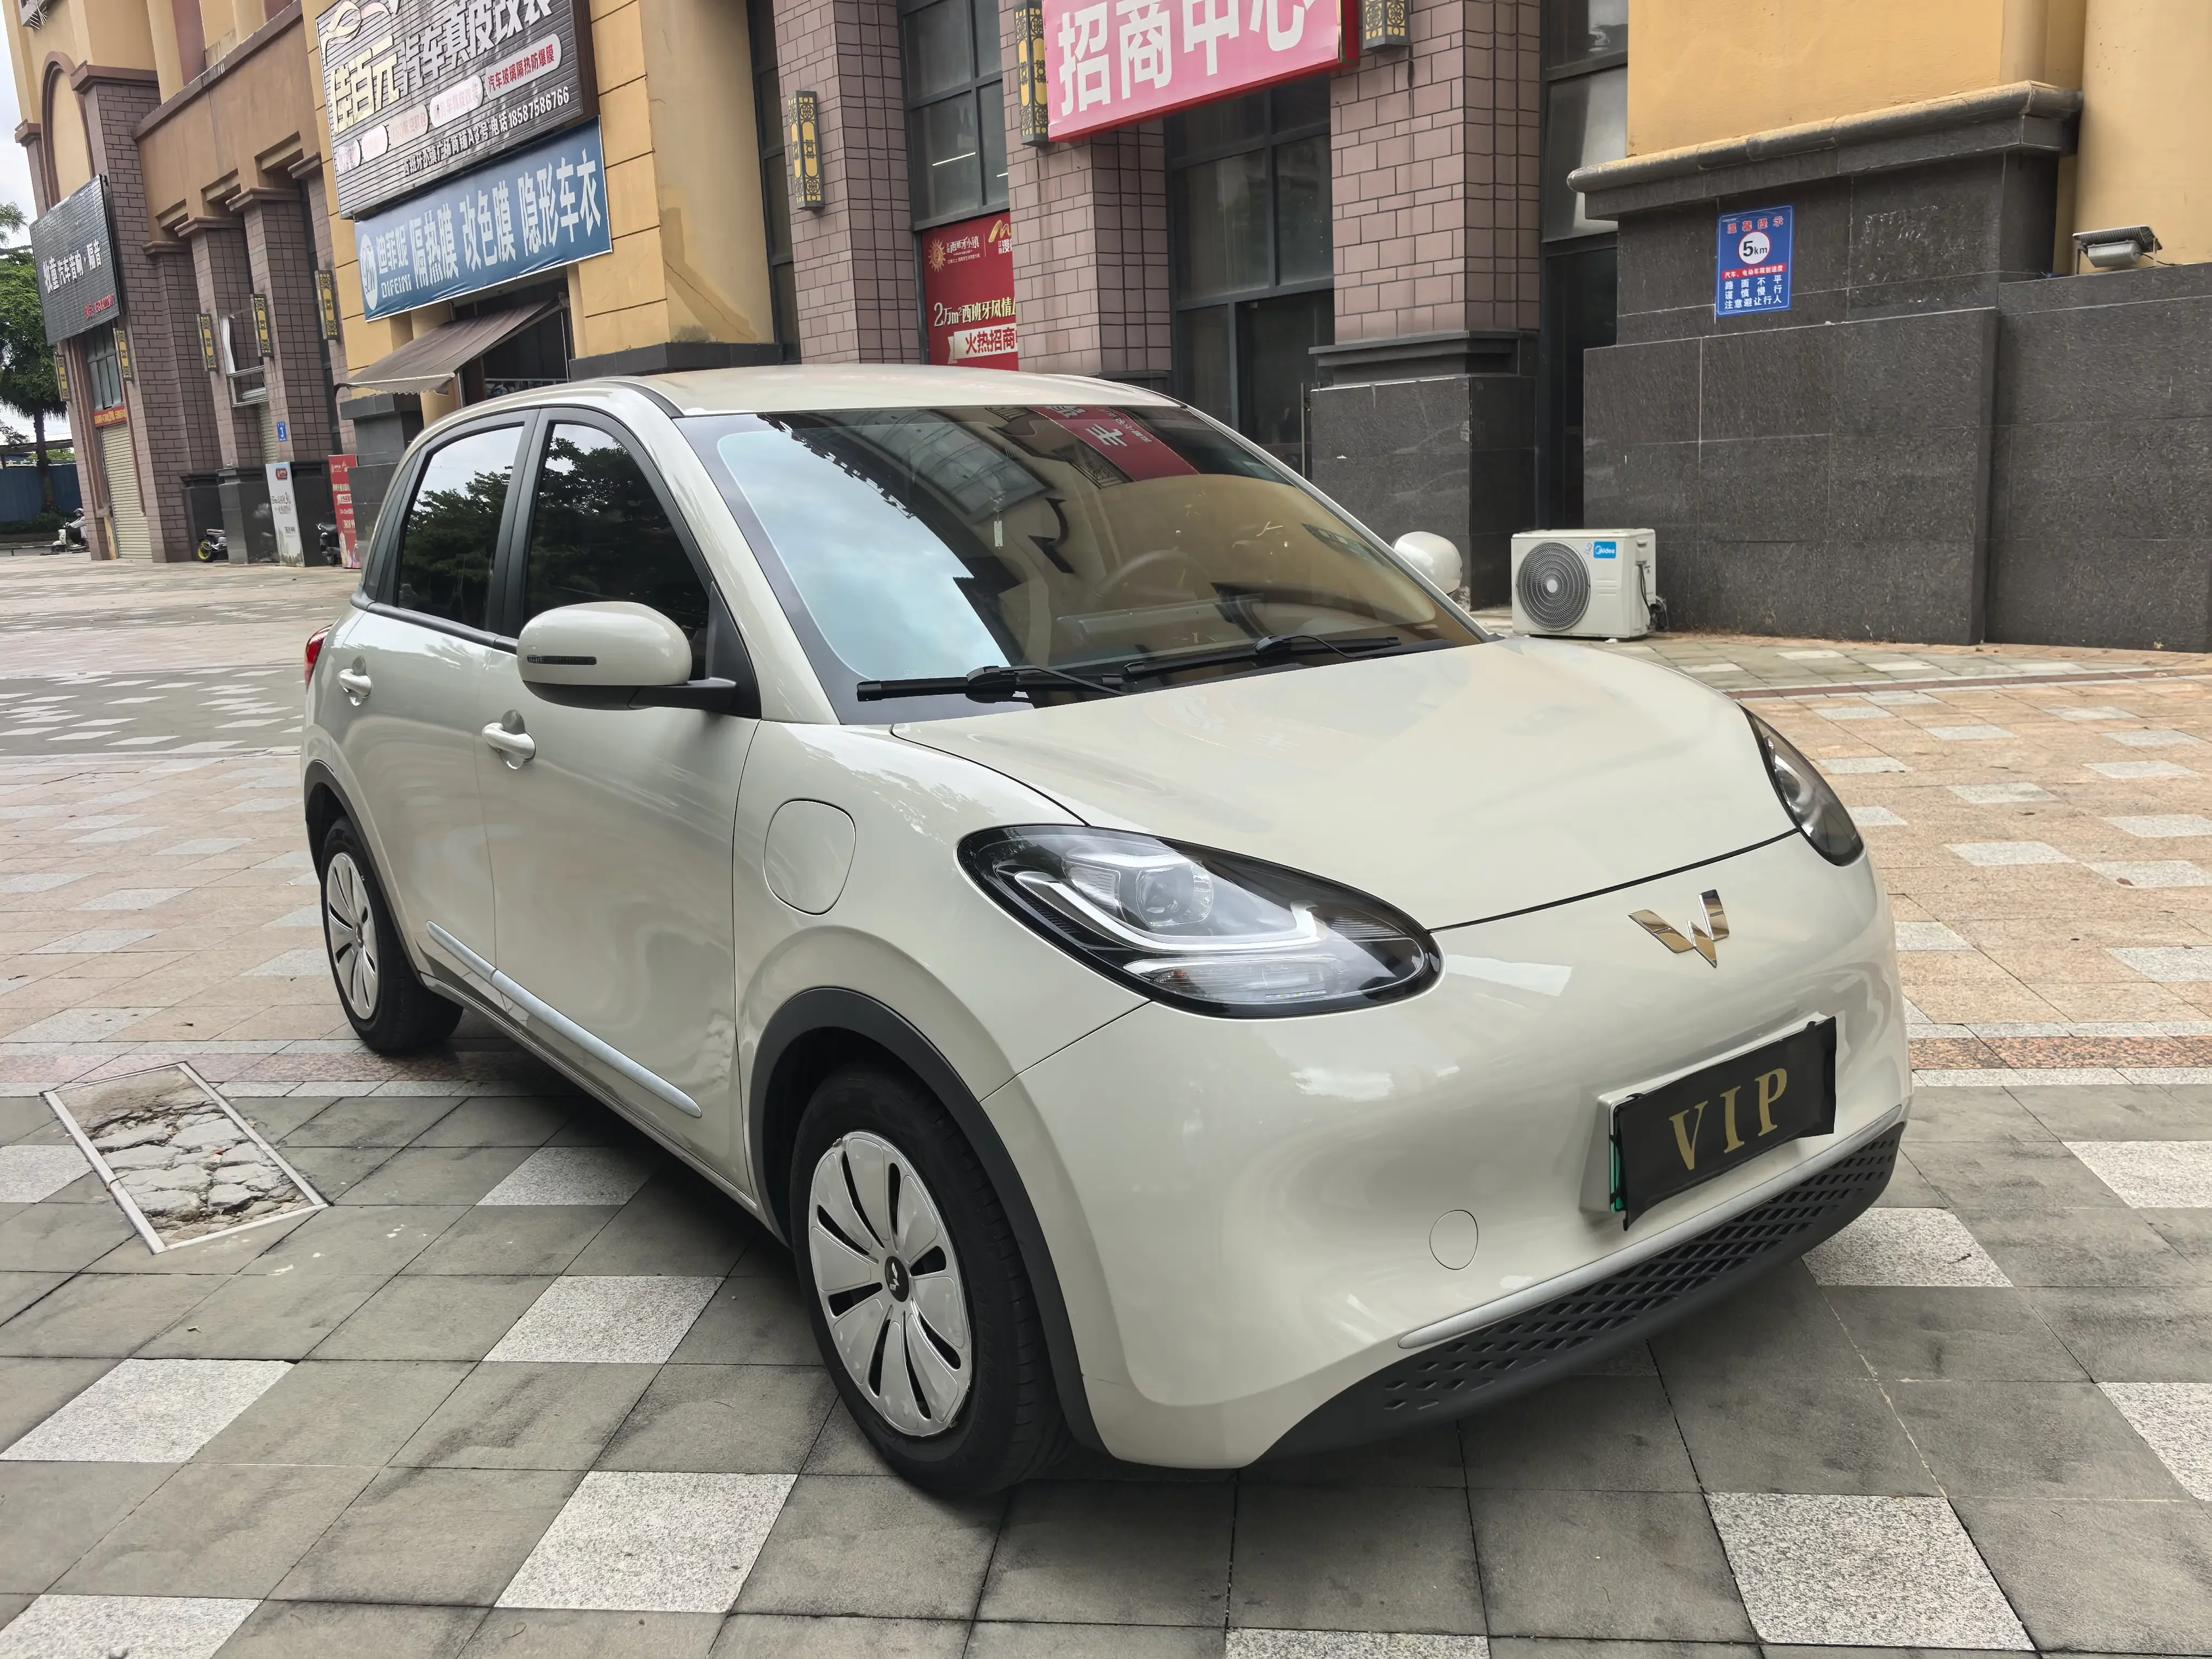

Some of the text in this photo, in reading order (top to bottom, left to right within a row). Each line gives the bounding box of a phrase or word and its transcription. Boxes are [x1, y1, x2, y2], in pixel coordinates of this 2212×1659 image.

[488, 44, 554, 93] 汽车玻璃隔热防爆膜
[1058, 0, 1316, 116] 招商中心
[409, 203, 459, 289] 隔热膜
[459, 180, 516, 272] 改色膜
[518, 148, 601, 257] 隐形车衣
[1727, 216, 1784, 234] 温馨提示
[1743, 240, 1768, 257] 5km
[1725, 275, 1782, 289] 路面不平
[1725, 285, 1782, 300] 谨慎慢行
[1724, 295, 1782, 309] 注意避让行人
[965, 327, 1017, 355] 火热招商
[1669, 1068, 1787, 1170] VIP
